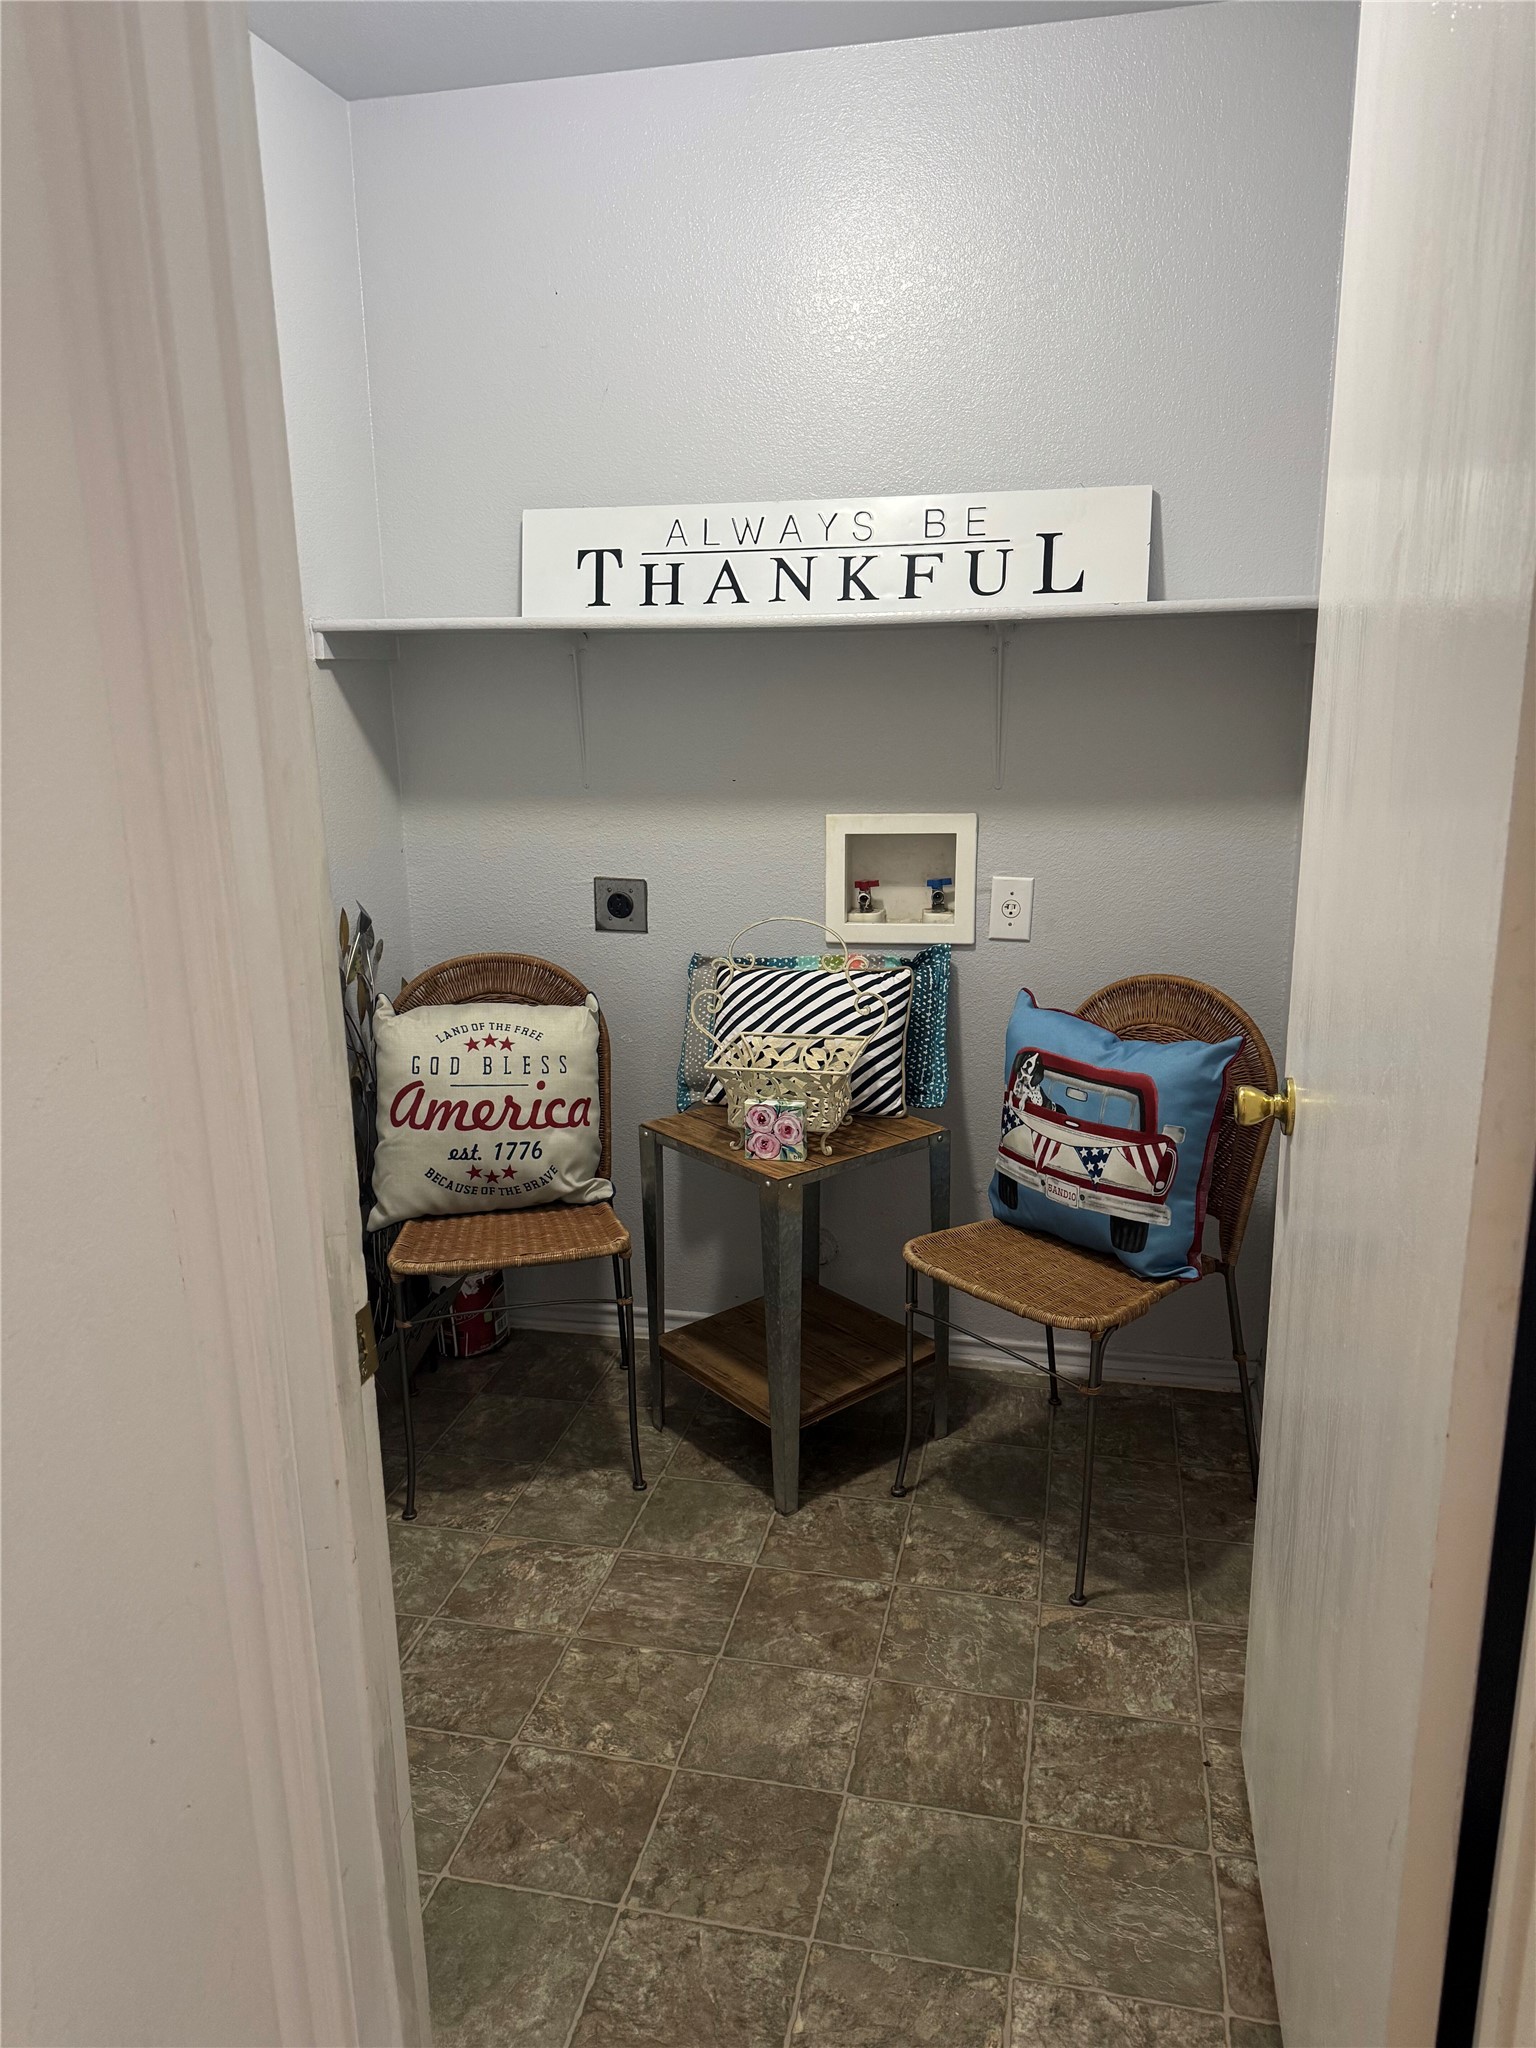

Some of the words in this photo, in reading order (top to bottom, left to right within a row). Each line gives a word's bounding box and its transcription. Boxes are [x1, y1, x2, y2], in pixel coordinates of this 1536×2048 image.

[666, 510, 875, 548] ALWAYS
[924, 506, 988, 538] BE
[577, 532, 1085, 608] THANKFUL
[435, 1024, 469, 1043] LAND
[471, 1022, 486, 1032] OF
[489, 1022, 512, 1032] THE
[514, 1025, 544, 1041] FREE
[411, 1056, 460, 1076] GOD
[483, 1055, 568, 1076] BLESS
[390, 1080, 592, 1132] America
[447, 1144, 482, 1161] est.
[495, 1141, 543, 1161] 1776
[424, 1167, 478, 1195] BECAUSE
[481, 1186, 496, 1195] OF
[498, 1185, 522, 1196] THE
[523, 1164, 559, 1192] BRAVE
